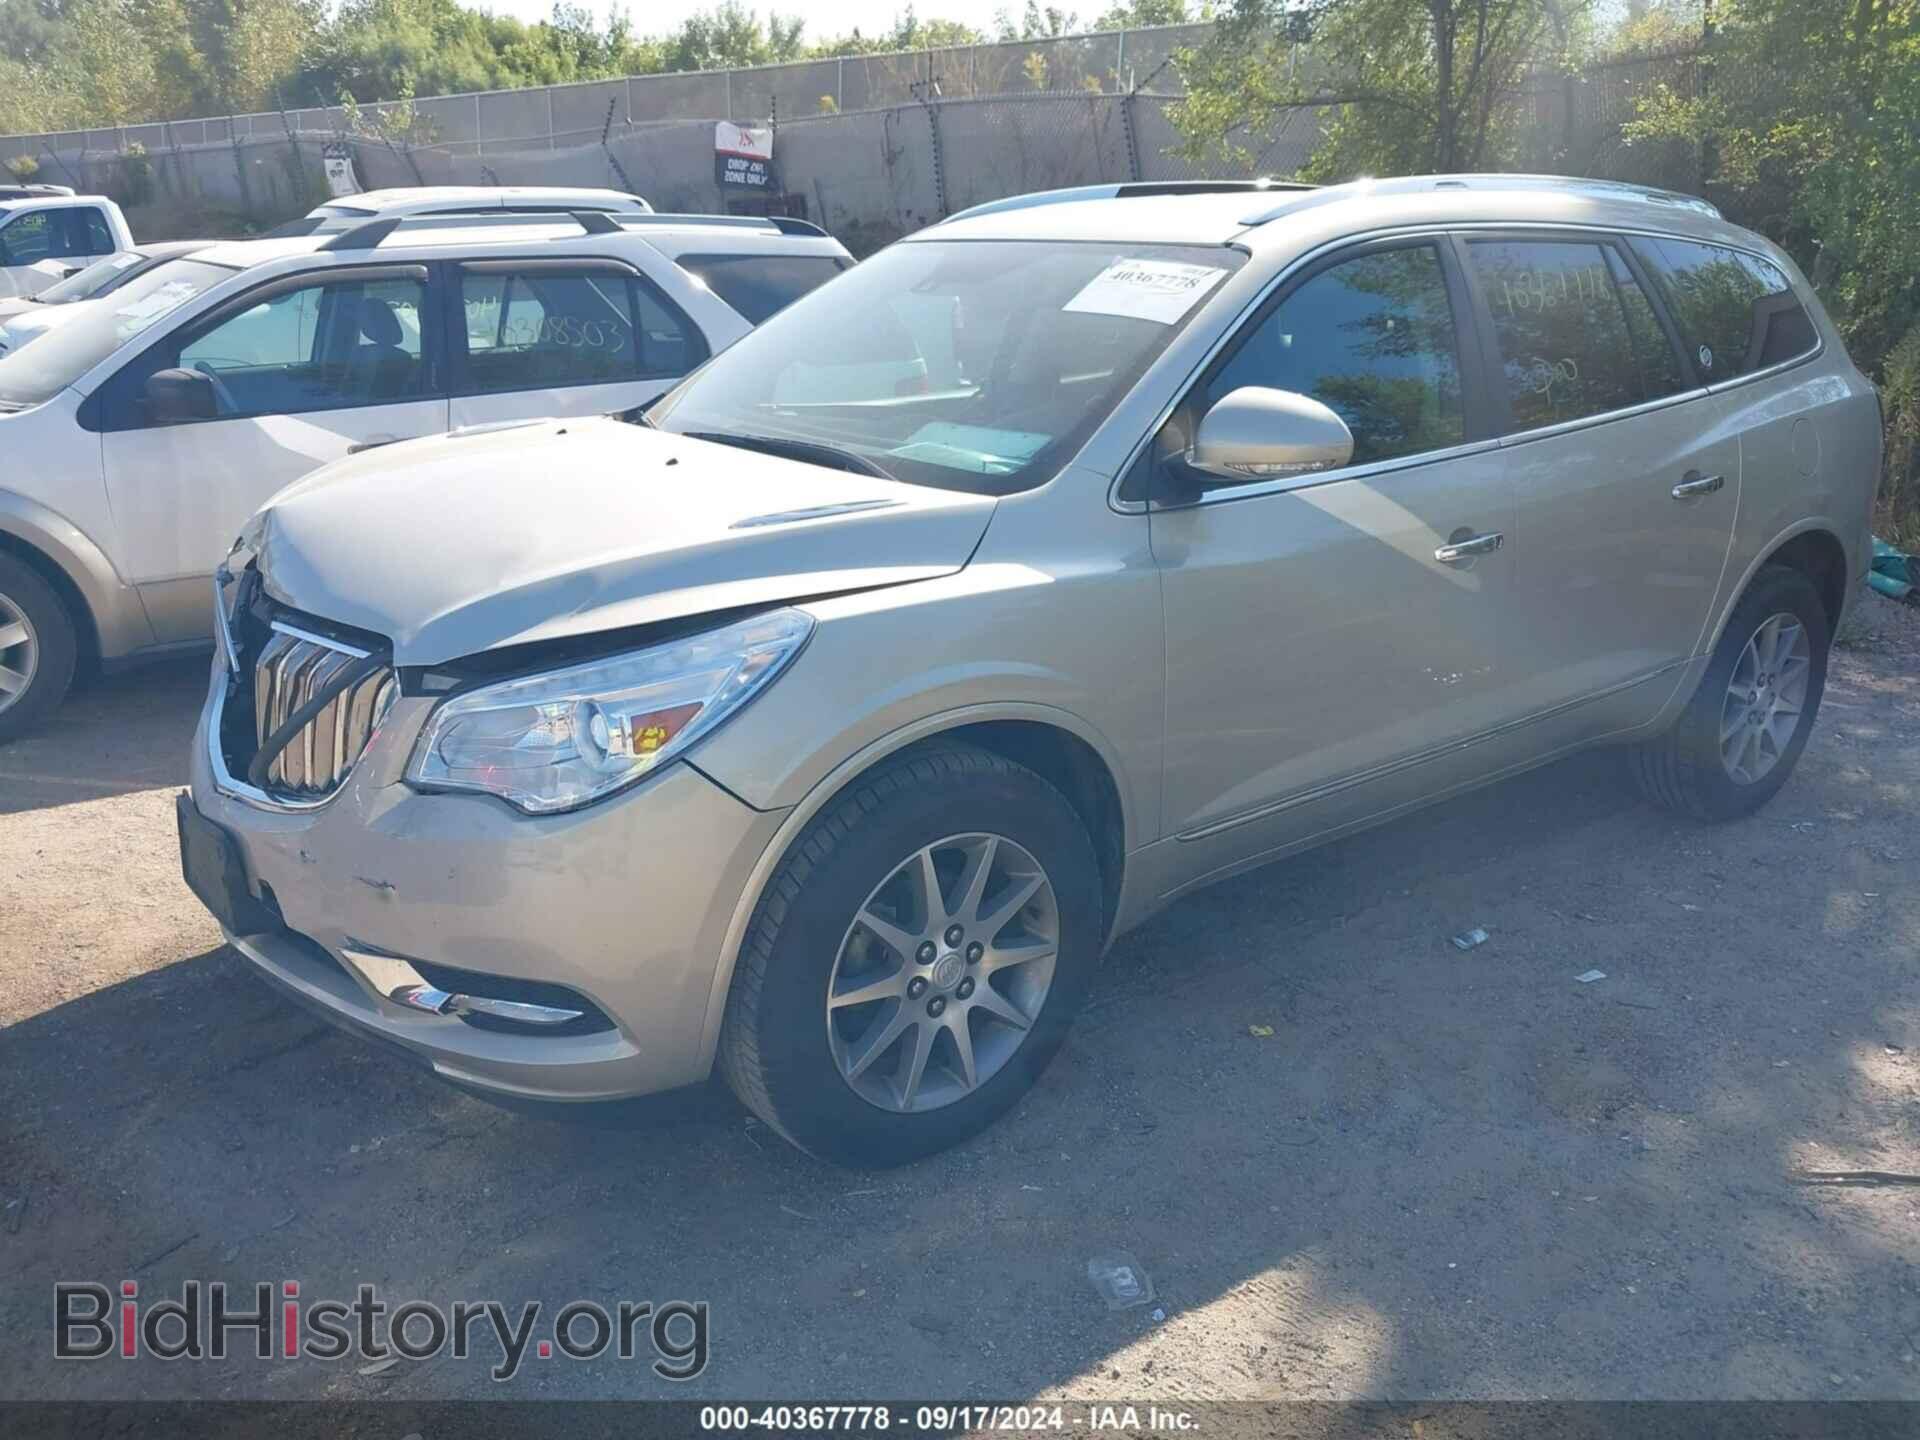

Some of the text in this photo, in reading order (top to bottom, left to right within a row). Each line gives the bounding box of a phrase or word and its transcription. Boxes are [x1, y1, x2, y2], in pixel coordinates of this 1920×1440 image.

[727, 158, 749, 171] DROP
[724, 170, 768, 185] ZONE ONLY
